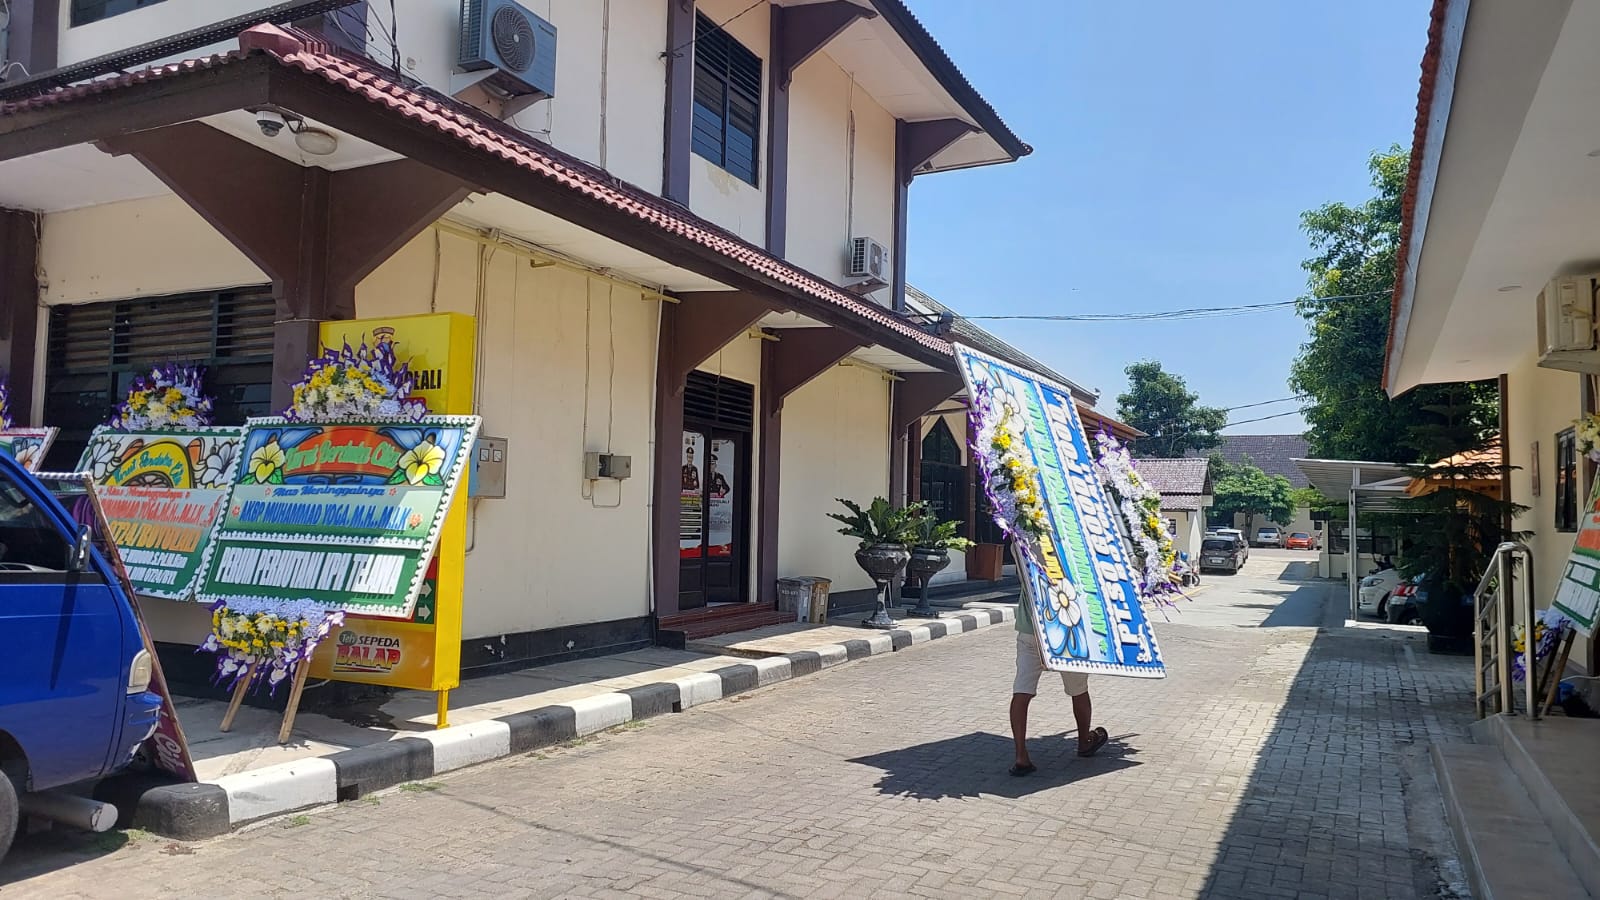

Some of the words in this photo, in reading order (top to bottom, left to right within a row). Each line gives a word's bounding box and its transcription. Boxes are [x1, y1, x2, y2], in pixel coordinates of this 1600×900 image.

[1046, 401, 1084, 474] FOOD
[263, 501, 323, 526] MUHAMMAD
[1070, 474, 1108, 554] GOOD
[215, 547, 261, 585] PERUM
[252, 549, 331, 589] PERHUTANI
[336, 645, 401, 670] BALAP
[359, 636, 400, 648] SEPEDA
